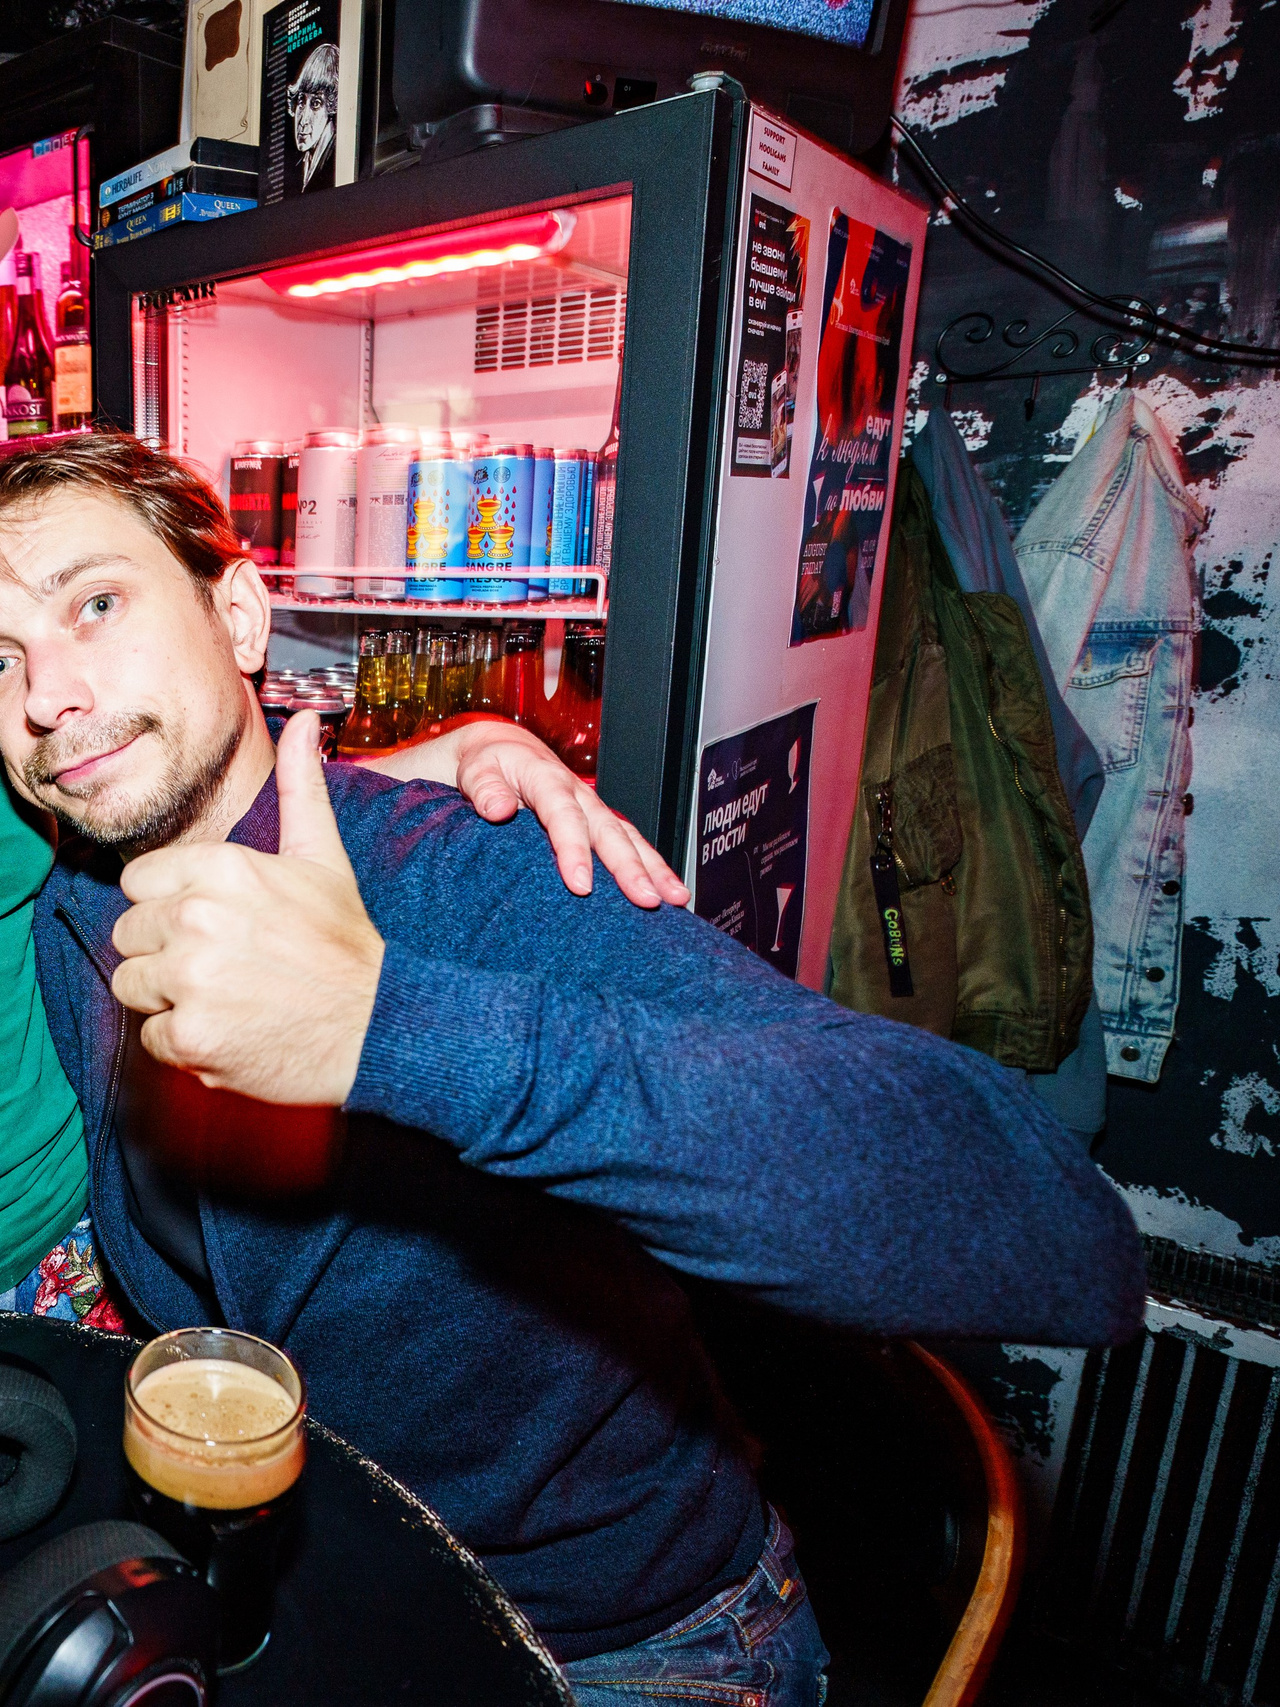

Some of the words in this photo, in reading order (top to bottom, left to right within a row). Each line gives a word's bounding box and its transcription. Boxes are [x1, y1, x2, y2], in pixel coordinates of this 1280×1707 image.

[287, 27, 323, 53] ЦВЕТАЕВА
[288, 21, 317, 44] МАРИНА
[764, 127, 786, 145] SUPPORT
[759, 142, 787, 163] HOOLIGANS
[762, 161, 780, 176] FAMILY
[111, 169, 143, 195] HERBALIFE
[118, 193, 150, 213] ТЕРМИНАТОР
[214, 199, 241, 211] QUEEN
[126, 214, 147, 232] QUEEN
[752, 241, 762, 253] не
[763, 246, 785, 262] звони
[751, 257, 788, 284] бывшему!
[749, 278, 775, 294] лучше
[776, 285, 796, 302] зайди
[748, 296, 754, 307] в
[755, 297, 767, 310] evi
[865, 415, 892, 441] едут
[565, 466, 577, 514] ЗДОРОВЬЮ
[839, 483, 884, 512] любви
[563, 516, 573, 553] ВАШЕМУ
[603, 522, 613, 550] ВАШЕМУ
[803, 543, 827, 558] AUGUST
[405, 562, 447, 572] SANGRE
[466, 562, 512, 572] SANGRE
[801, 560, 824, 576] FRIDAY
[703, 796, 742, 836] люди
[741, 782, 769, 819] едут
[710, 822, 747, 864] гости
